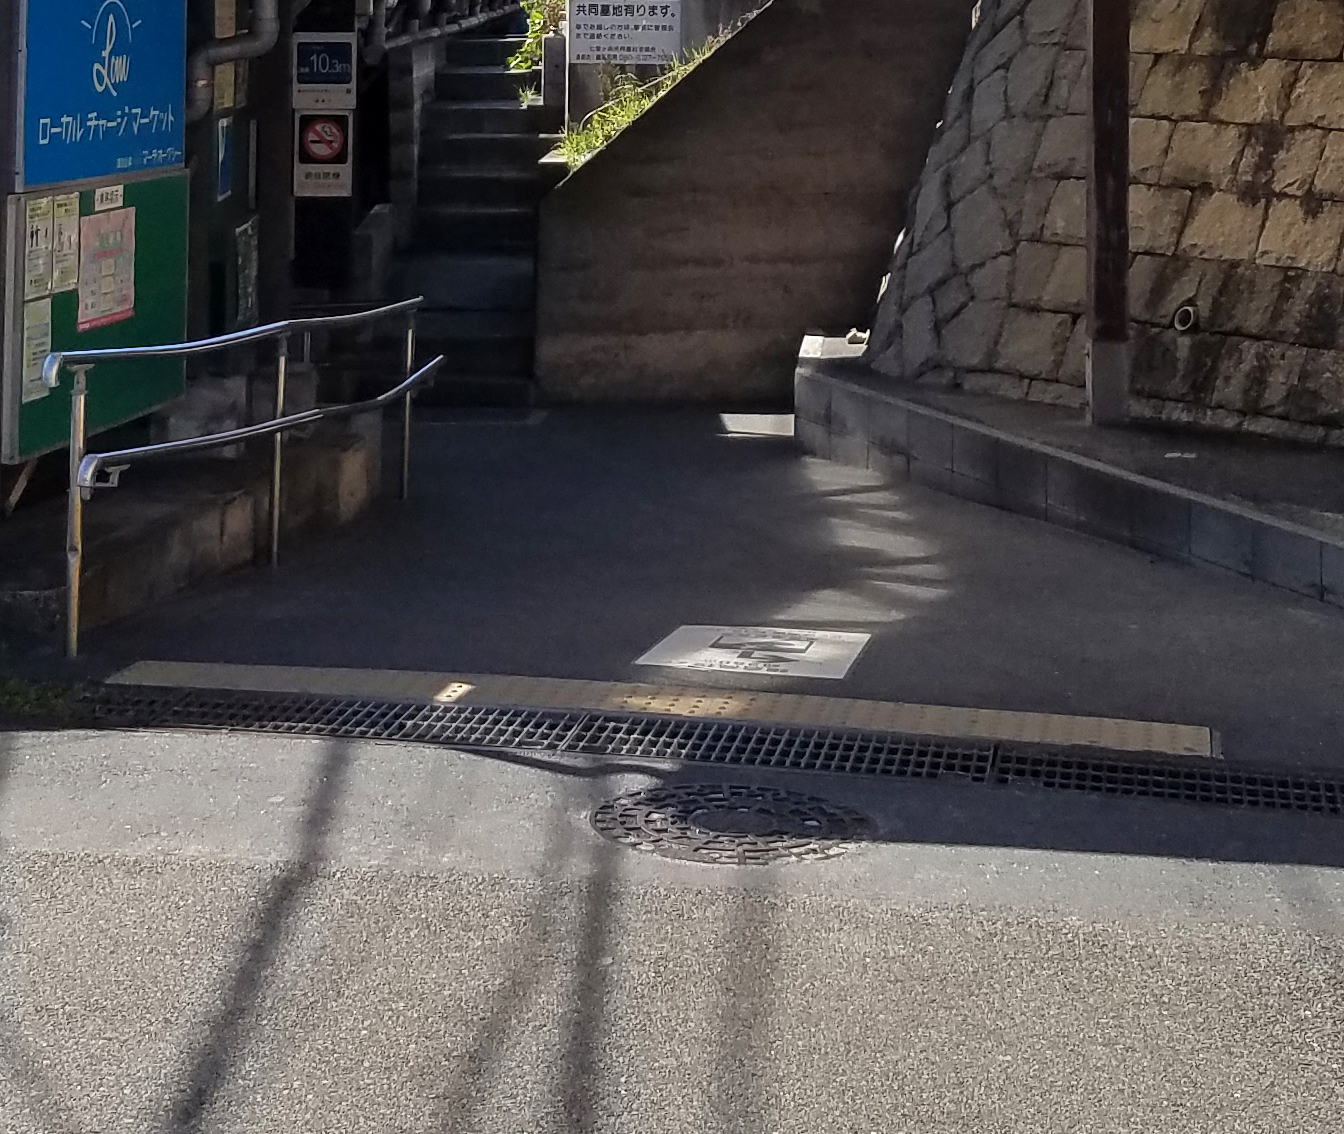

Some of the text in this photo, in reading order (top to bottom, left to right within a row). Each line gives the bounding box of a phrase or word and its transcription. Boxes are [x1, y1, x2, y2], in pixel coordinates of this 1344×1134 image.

[576, 4, 676, 17] 共同墓地有ります。
